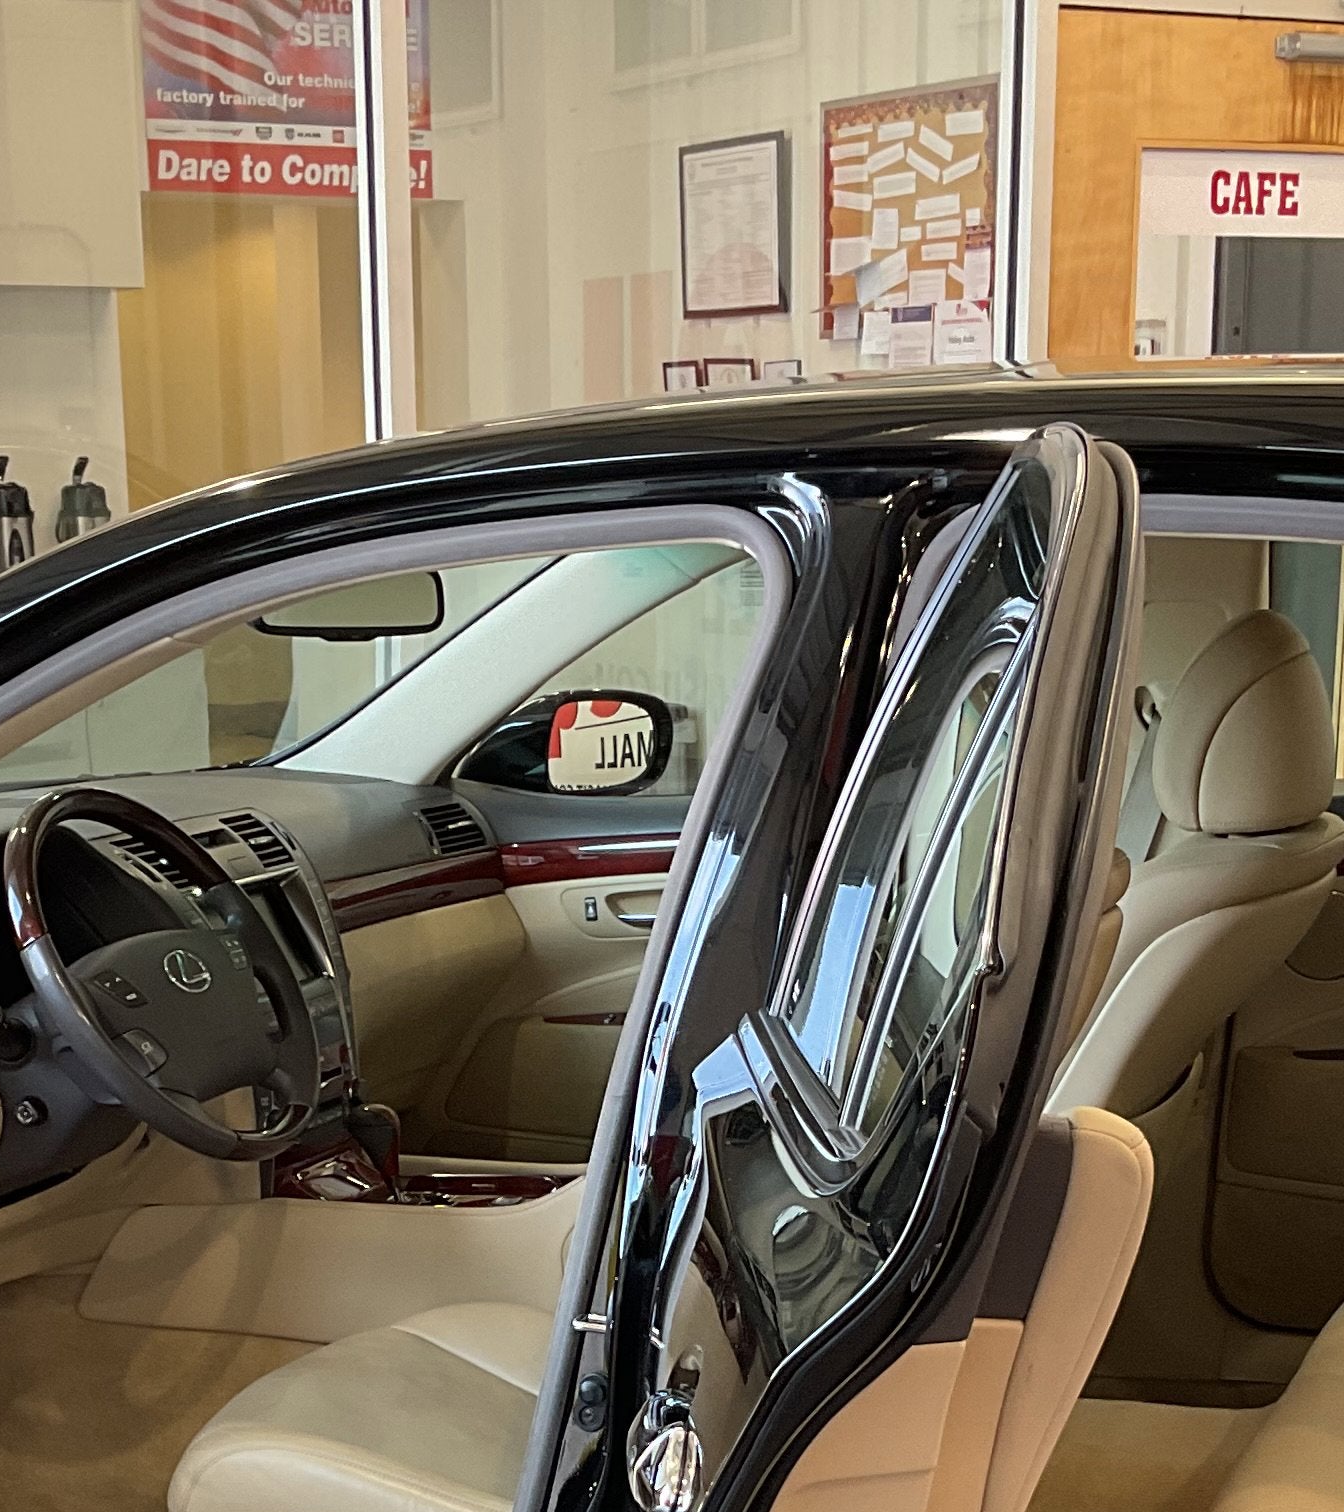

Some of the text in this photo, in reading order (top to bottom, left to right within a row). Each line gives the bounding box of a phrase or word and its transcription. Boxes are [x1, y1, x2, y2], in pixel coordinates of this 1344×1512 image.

[264, 71, 293, 86] Our
[157, 87, 306, 108] factory trained for
[158, 150, 230, 182] Dare
[241, 154, 272, 184] to
[1211, 170, 1300, 216] CAFE
